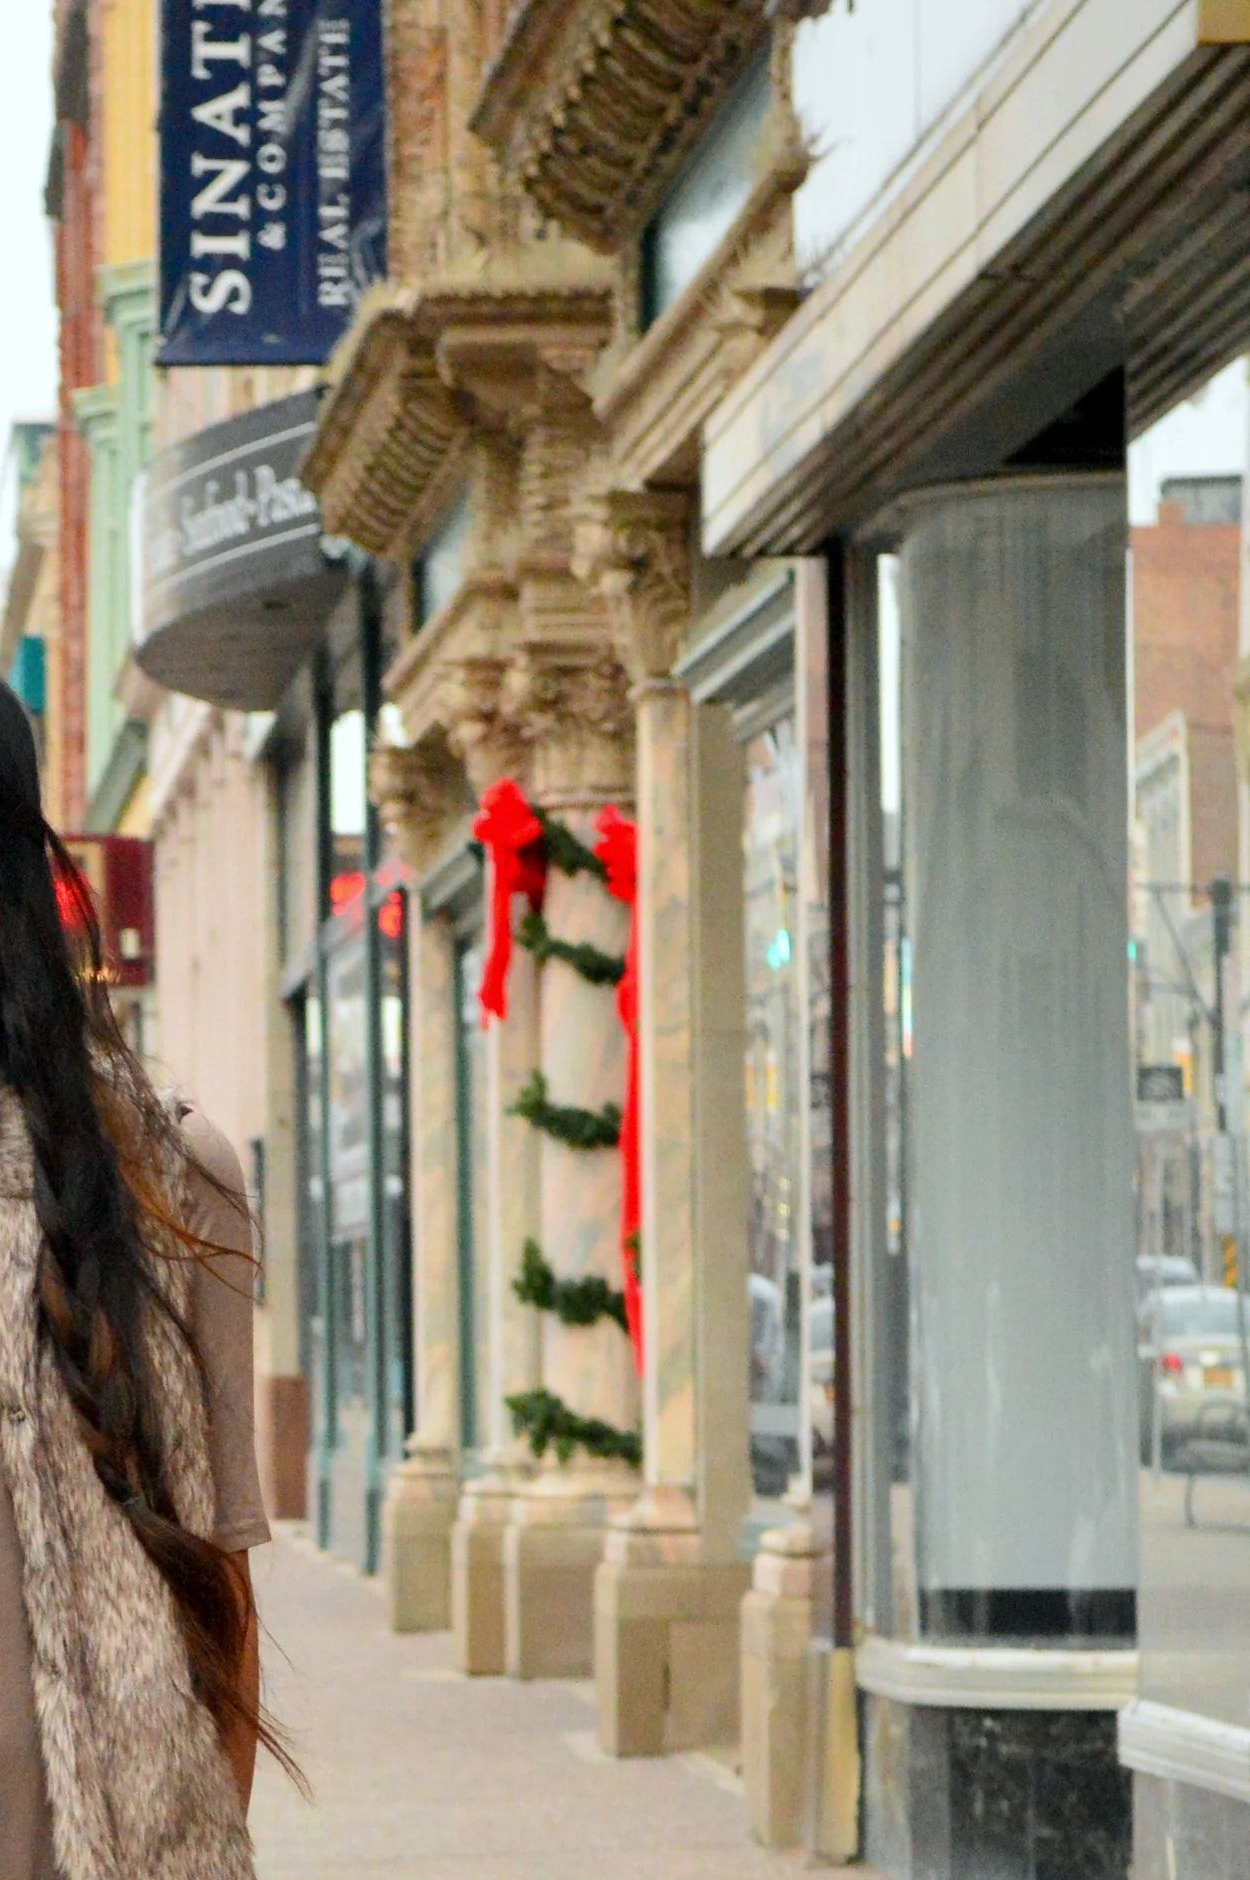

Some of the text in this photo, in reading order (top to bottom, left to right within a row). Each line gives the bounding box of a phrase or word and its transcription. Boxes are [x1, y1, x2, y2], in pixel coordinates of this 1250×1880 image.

[190, 0, 252, 316] SINAT
[317, 18, 350, 306] REAL ESTATE
